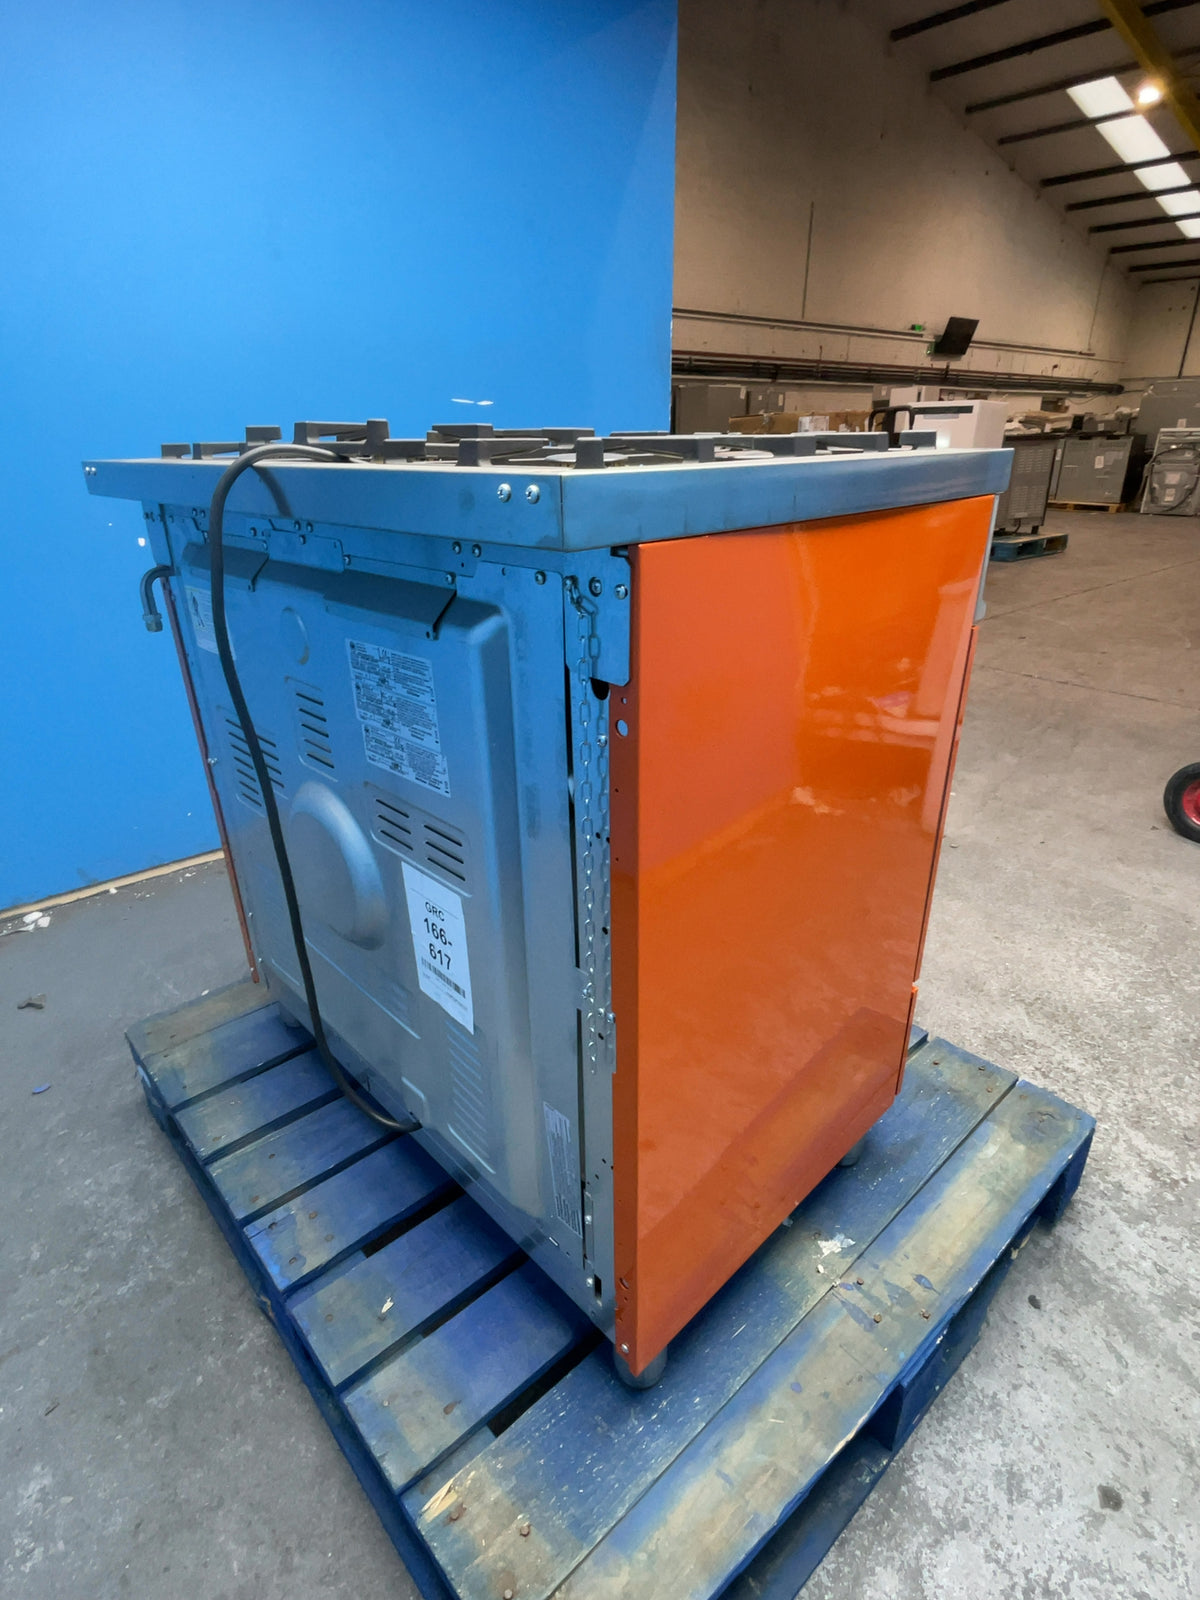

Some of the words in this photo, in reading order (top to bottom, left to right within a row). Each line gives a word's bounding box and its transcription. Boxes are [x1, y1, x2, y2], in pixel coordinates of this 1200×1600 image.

[425, 901, 445, 922] GRC
[424, 917, 453, 946] 166-
[429, 942, 452, 970] 617
